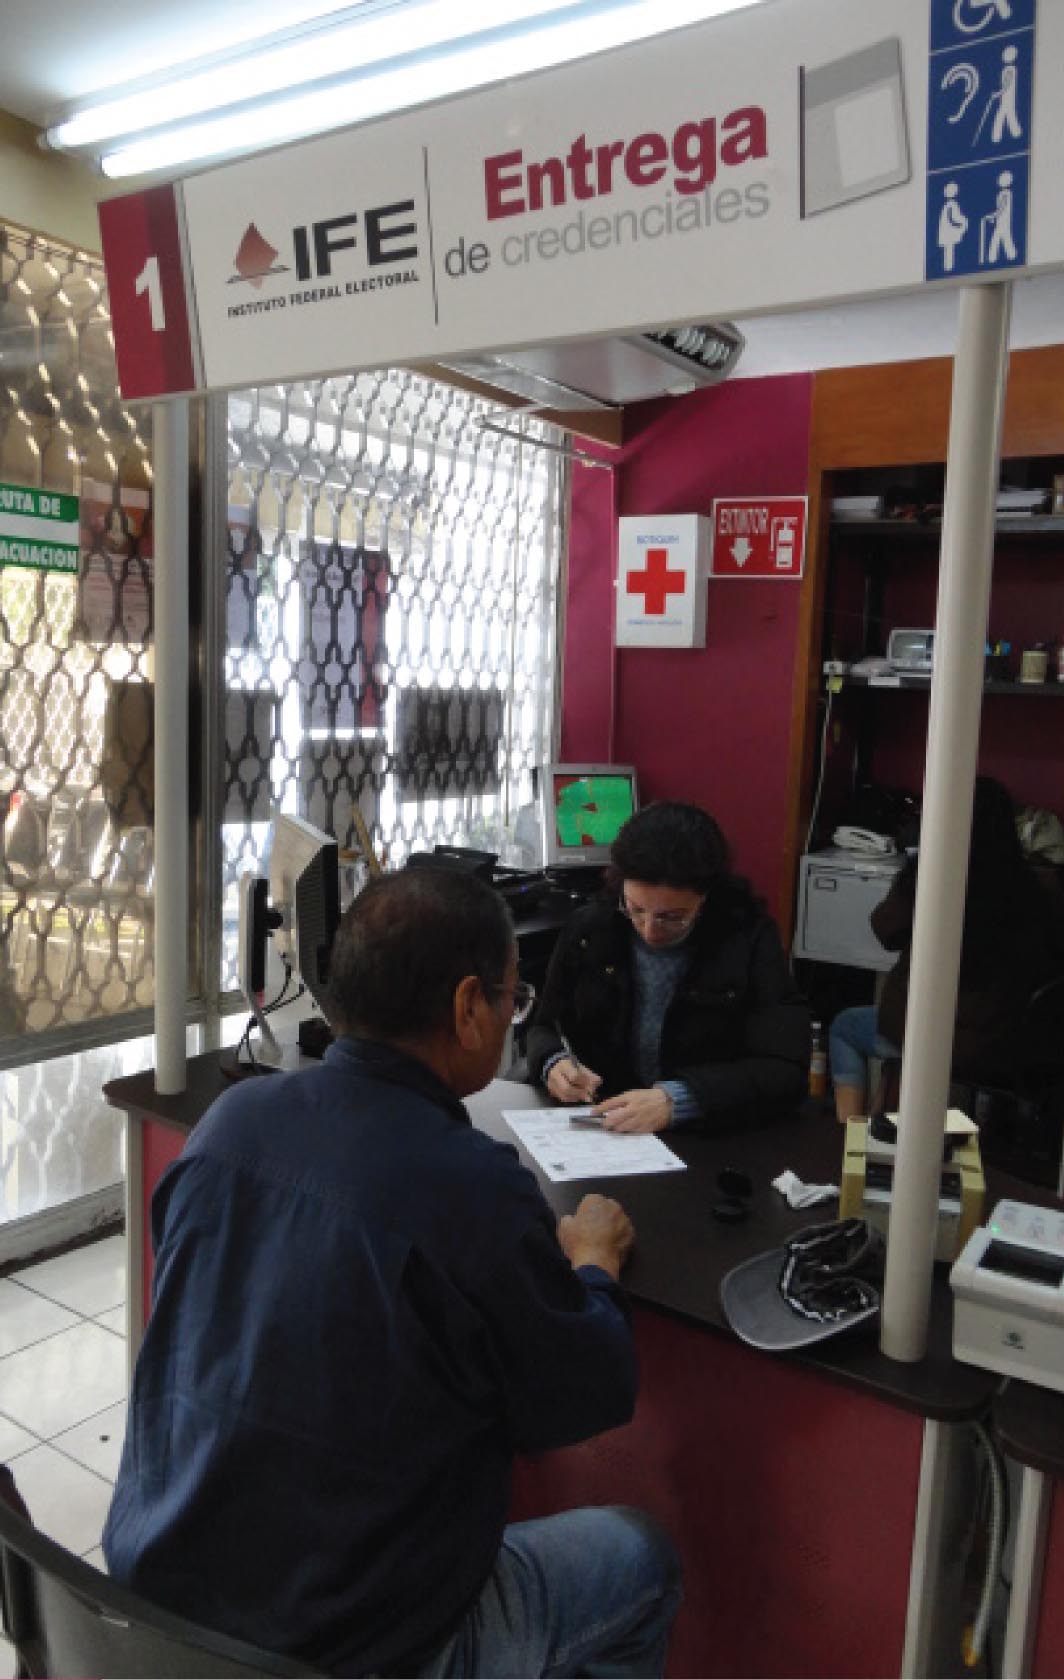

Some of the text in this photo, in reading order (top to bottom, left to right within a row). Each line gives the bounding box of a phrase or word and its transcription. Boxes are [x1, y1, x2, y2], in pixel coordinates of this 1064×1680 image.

[484, 105, 768, 221] Entrega
[293, 199, 418, 281] IFE
[444, 182, 770, 278] de credenciales
[135, 256, 166, 331] 1
[227, 269, 420, 318] INSTITUTO FEDERAL ELECTORAL
[0, 487, 60, 518] UTA DE
